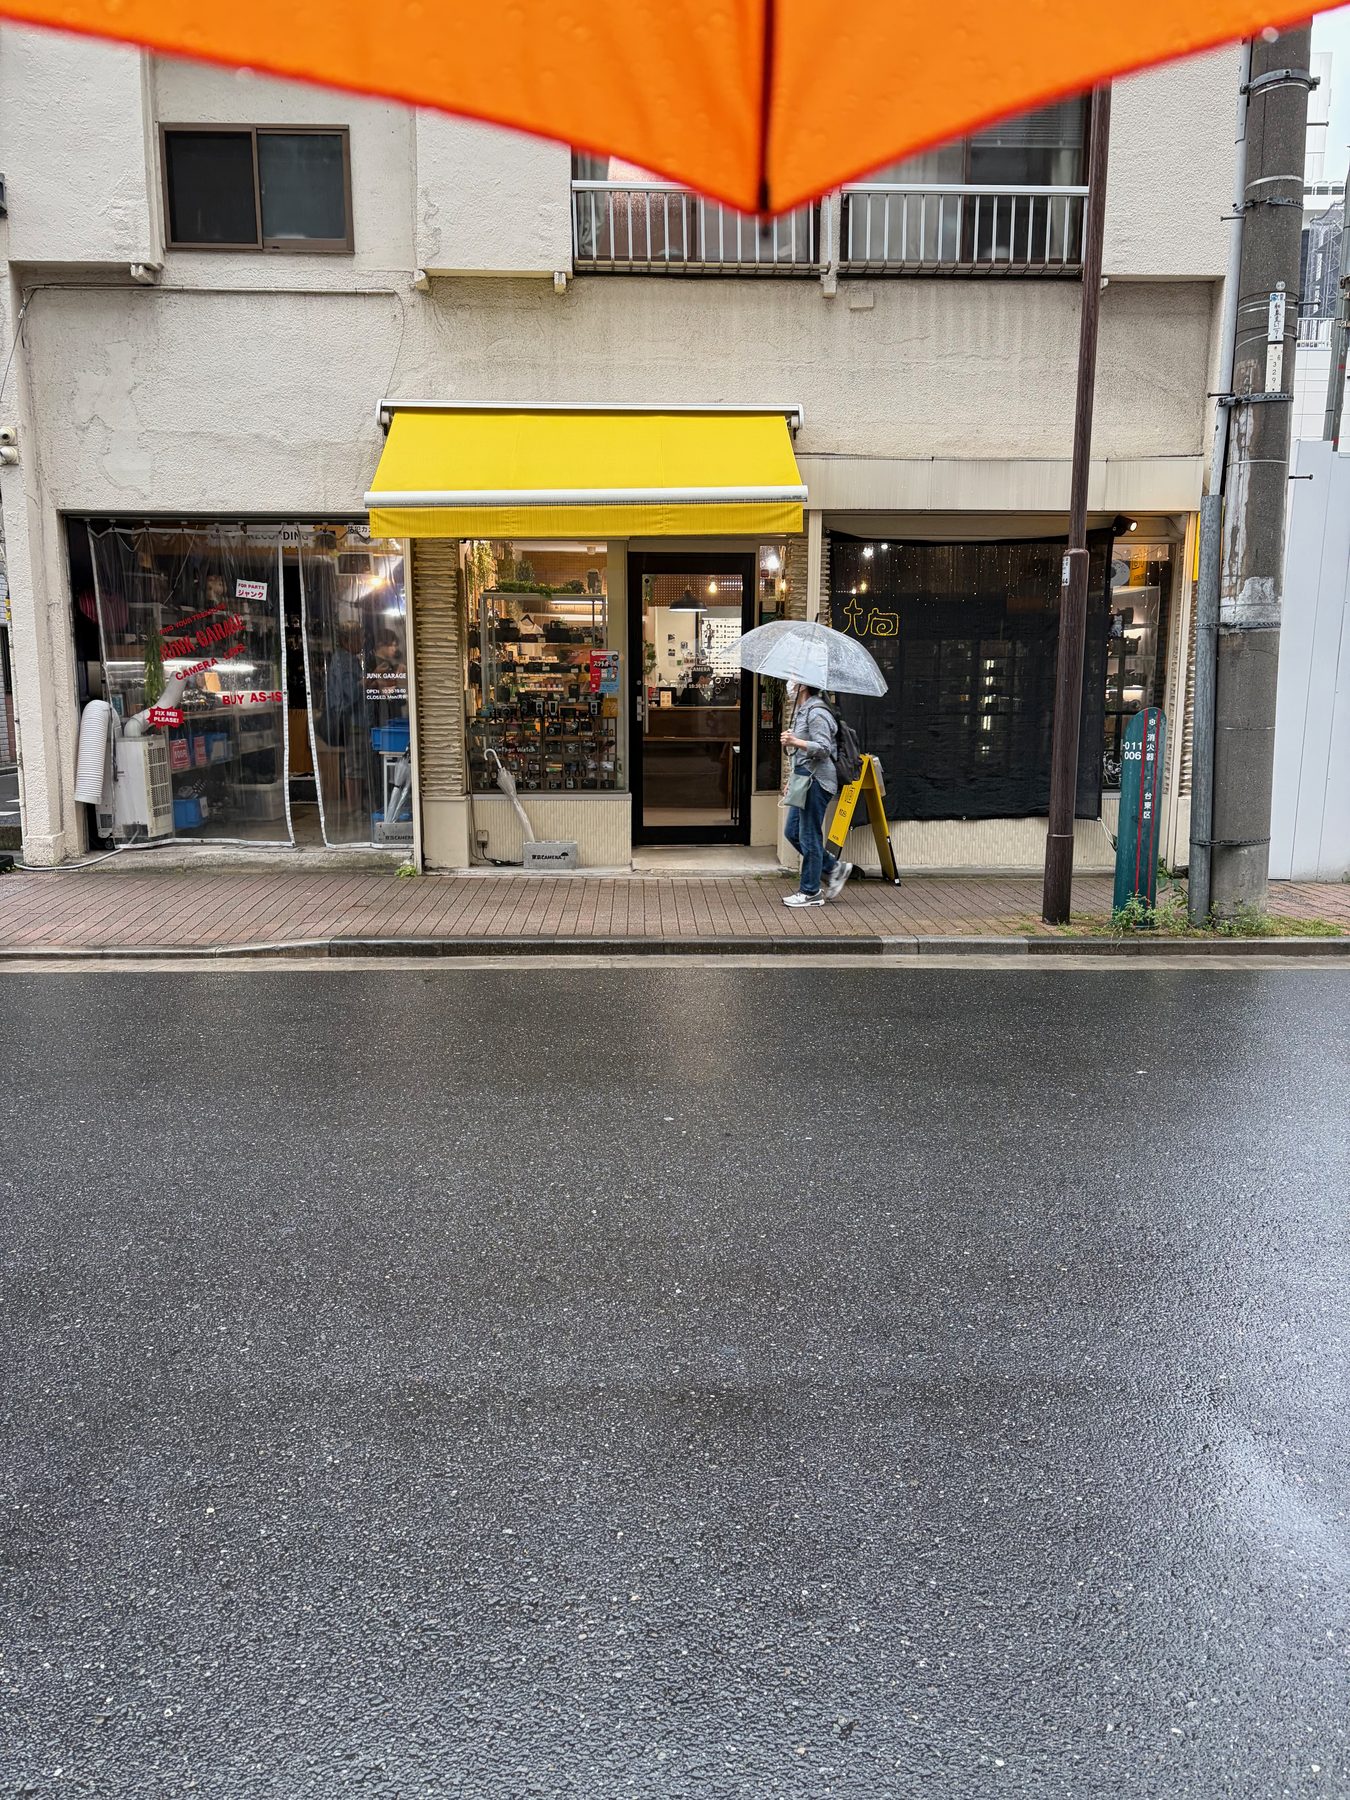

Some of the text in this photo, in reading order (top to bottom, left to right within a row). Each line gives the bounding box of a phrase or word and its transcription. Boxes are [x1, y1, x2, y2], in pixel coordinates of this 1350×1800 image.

[237, 589, 264, 599] ジャンク
[176, 657, 219, 680] CAMERA
[222, 691, 283, 705] BUY AS-IS
[1124, 751, 1142, 760] 006
[1146, 733, 1156, 761] 消火器
[1143, 792, 1153, 819] 台東区
